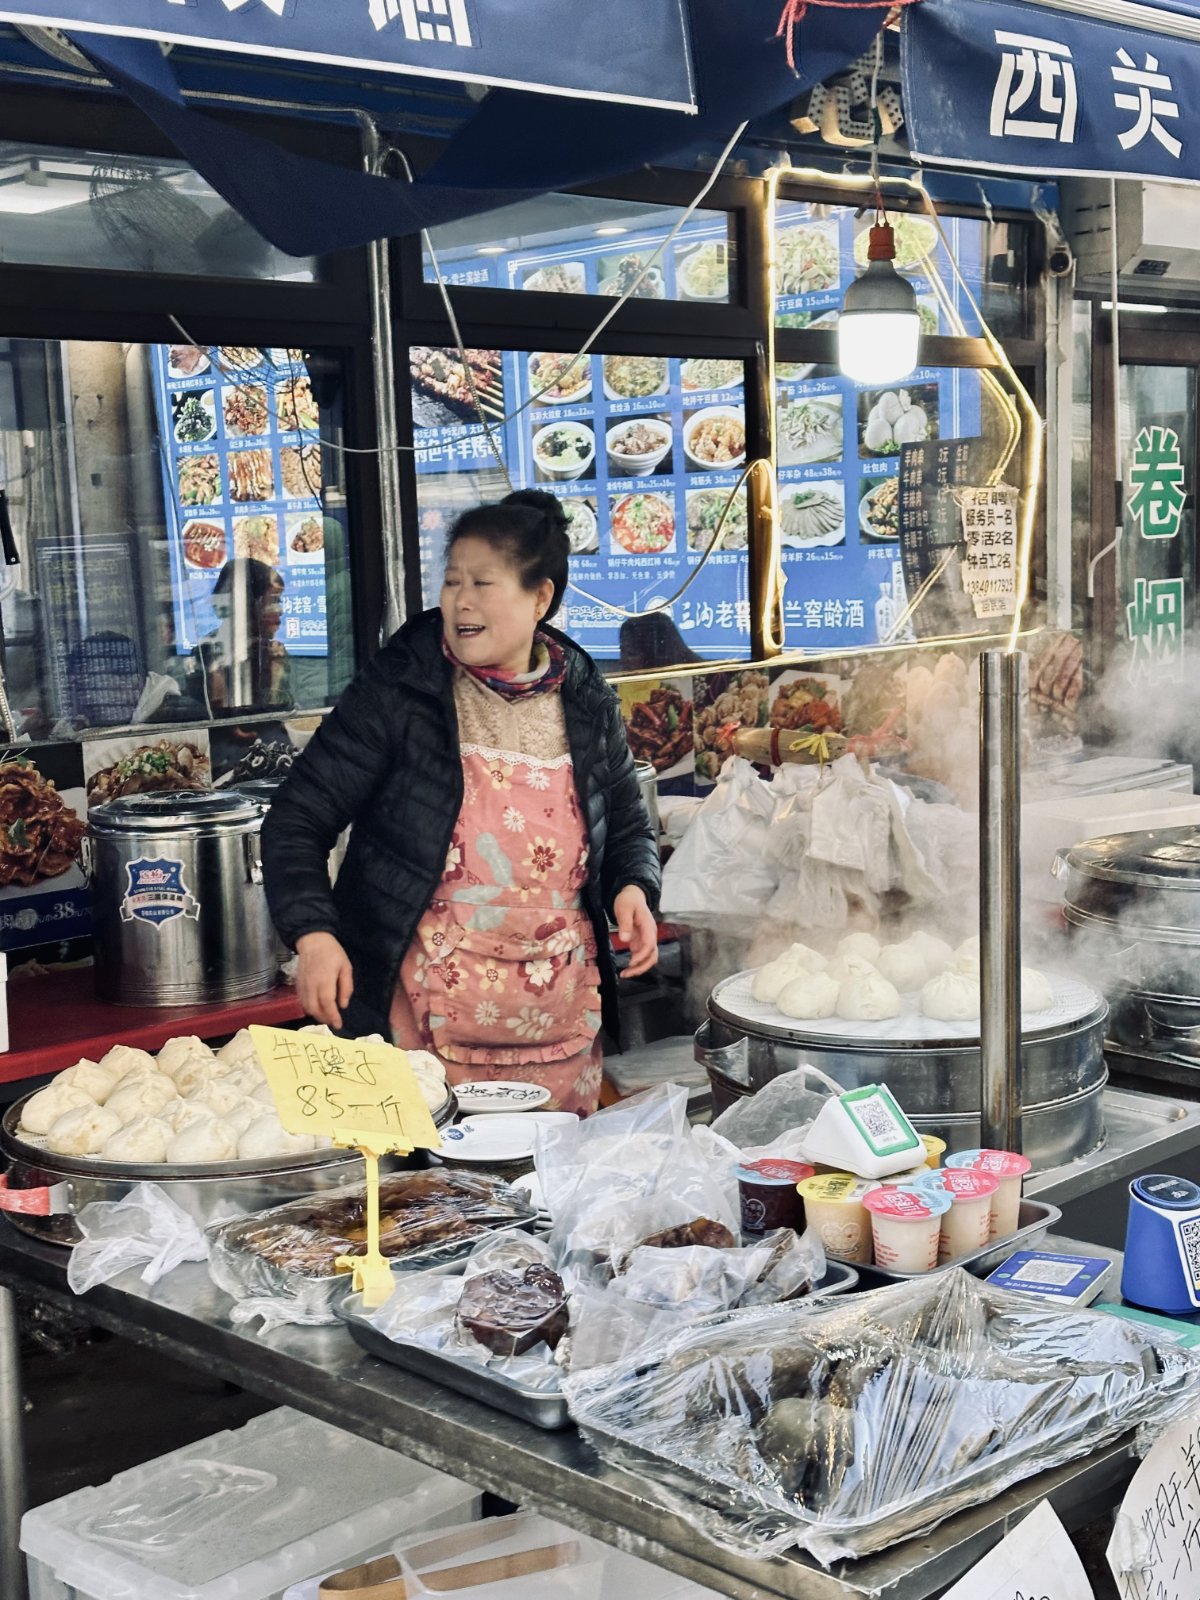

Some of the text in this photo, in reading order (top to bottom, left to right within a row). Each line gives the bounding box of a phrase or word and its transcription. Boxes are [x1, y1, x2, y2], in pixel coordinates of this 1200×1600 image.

[990, 30, 1182, 159] 西关
[973, 491, 1008, 506] 招聘
[966, 508, 1013, 527] 服务员一名
